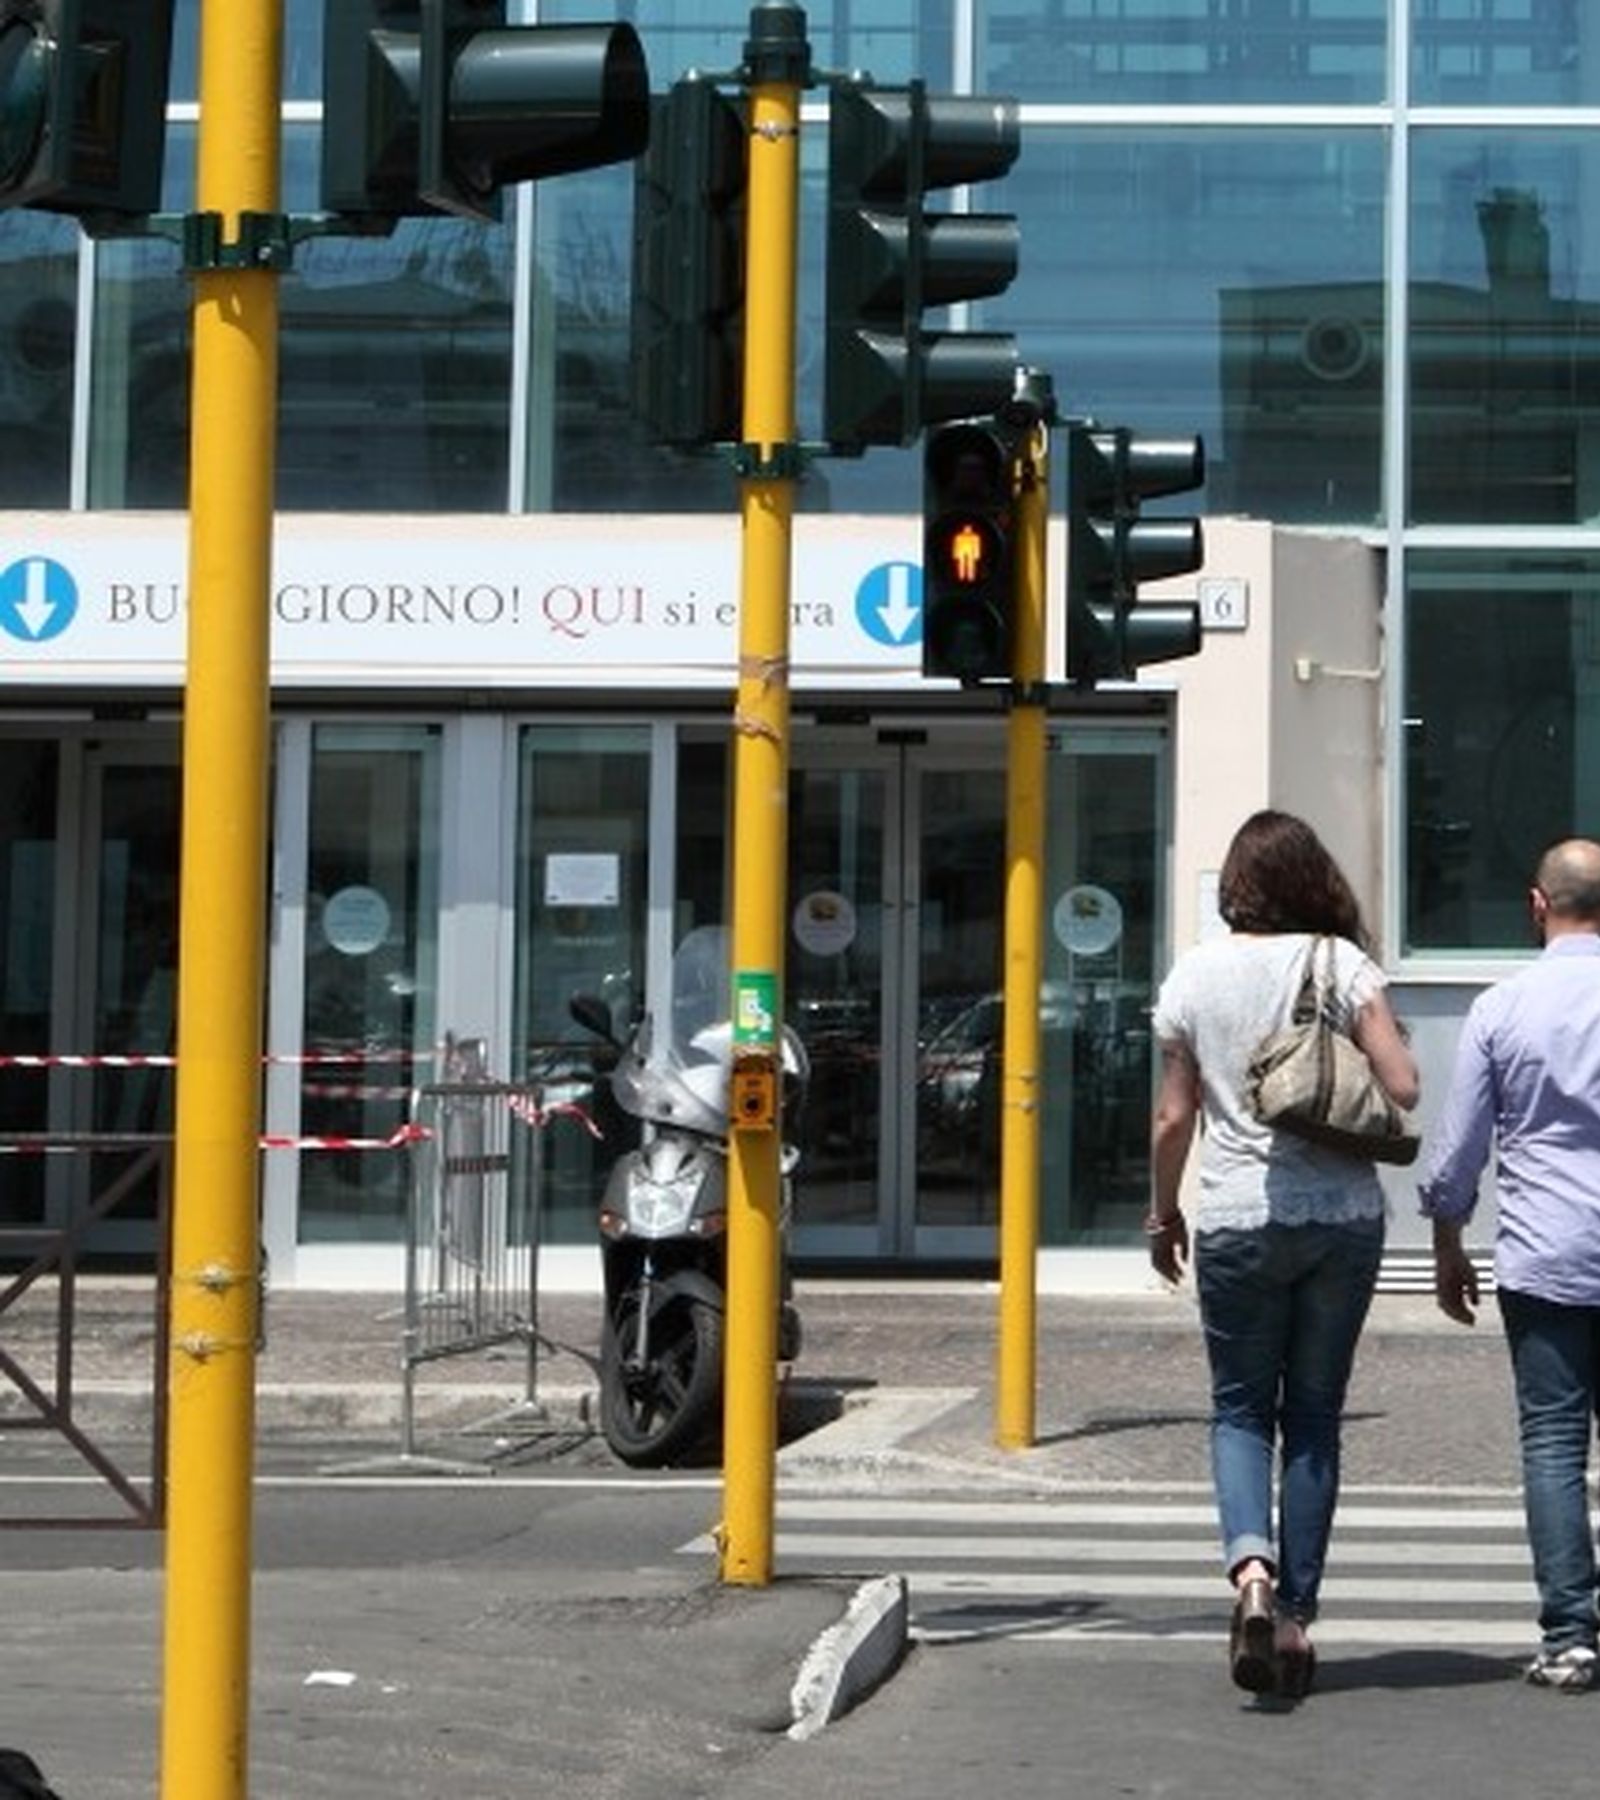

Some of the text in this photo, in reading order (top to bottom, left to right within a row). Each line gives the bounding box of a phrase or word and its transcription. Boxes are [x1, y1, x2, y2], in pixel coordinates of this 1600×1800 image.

[108, 583, 835, 639] BUGIORNO! QUI si era
[1214, 590, 1232, 619] 6
